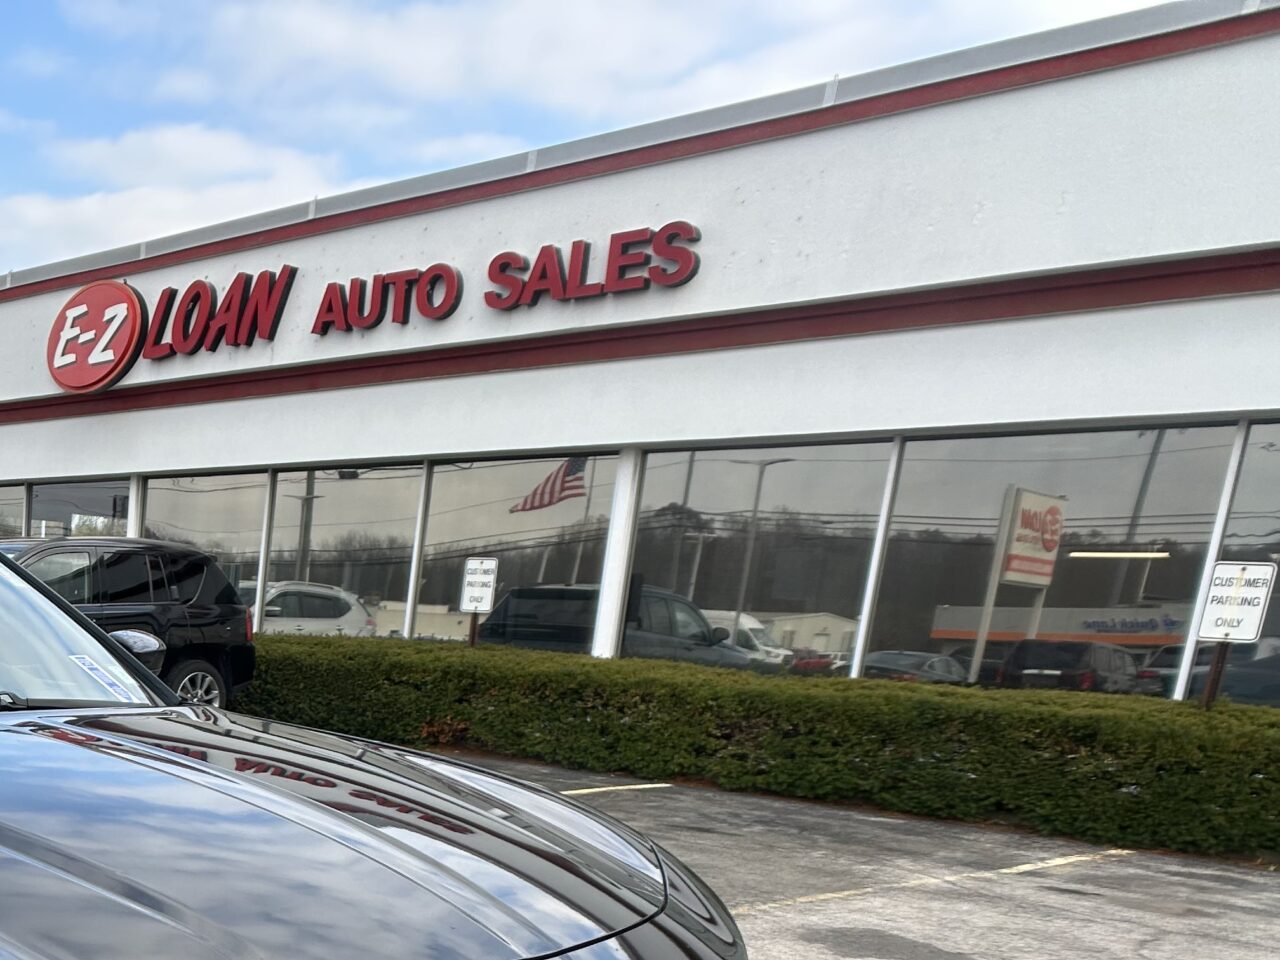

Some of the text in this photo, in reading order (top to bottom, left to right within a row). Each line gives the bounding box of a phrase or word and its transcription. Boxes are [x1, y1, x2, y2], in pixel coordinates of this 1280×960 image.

[52, 220, 702, 369] E-Z LOAN AUTO SALES
[1213, 576, 1269, 588] CUSTOMER
[1210, 595, 1261, 606] PARKING
[1214, 617, 1243, 628] ONLY
